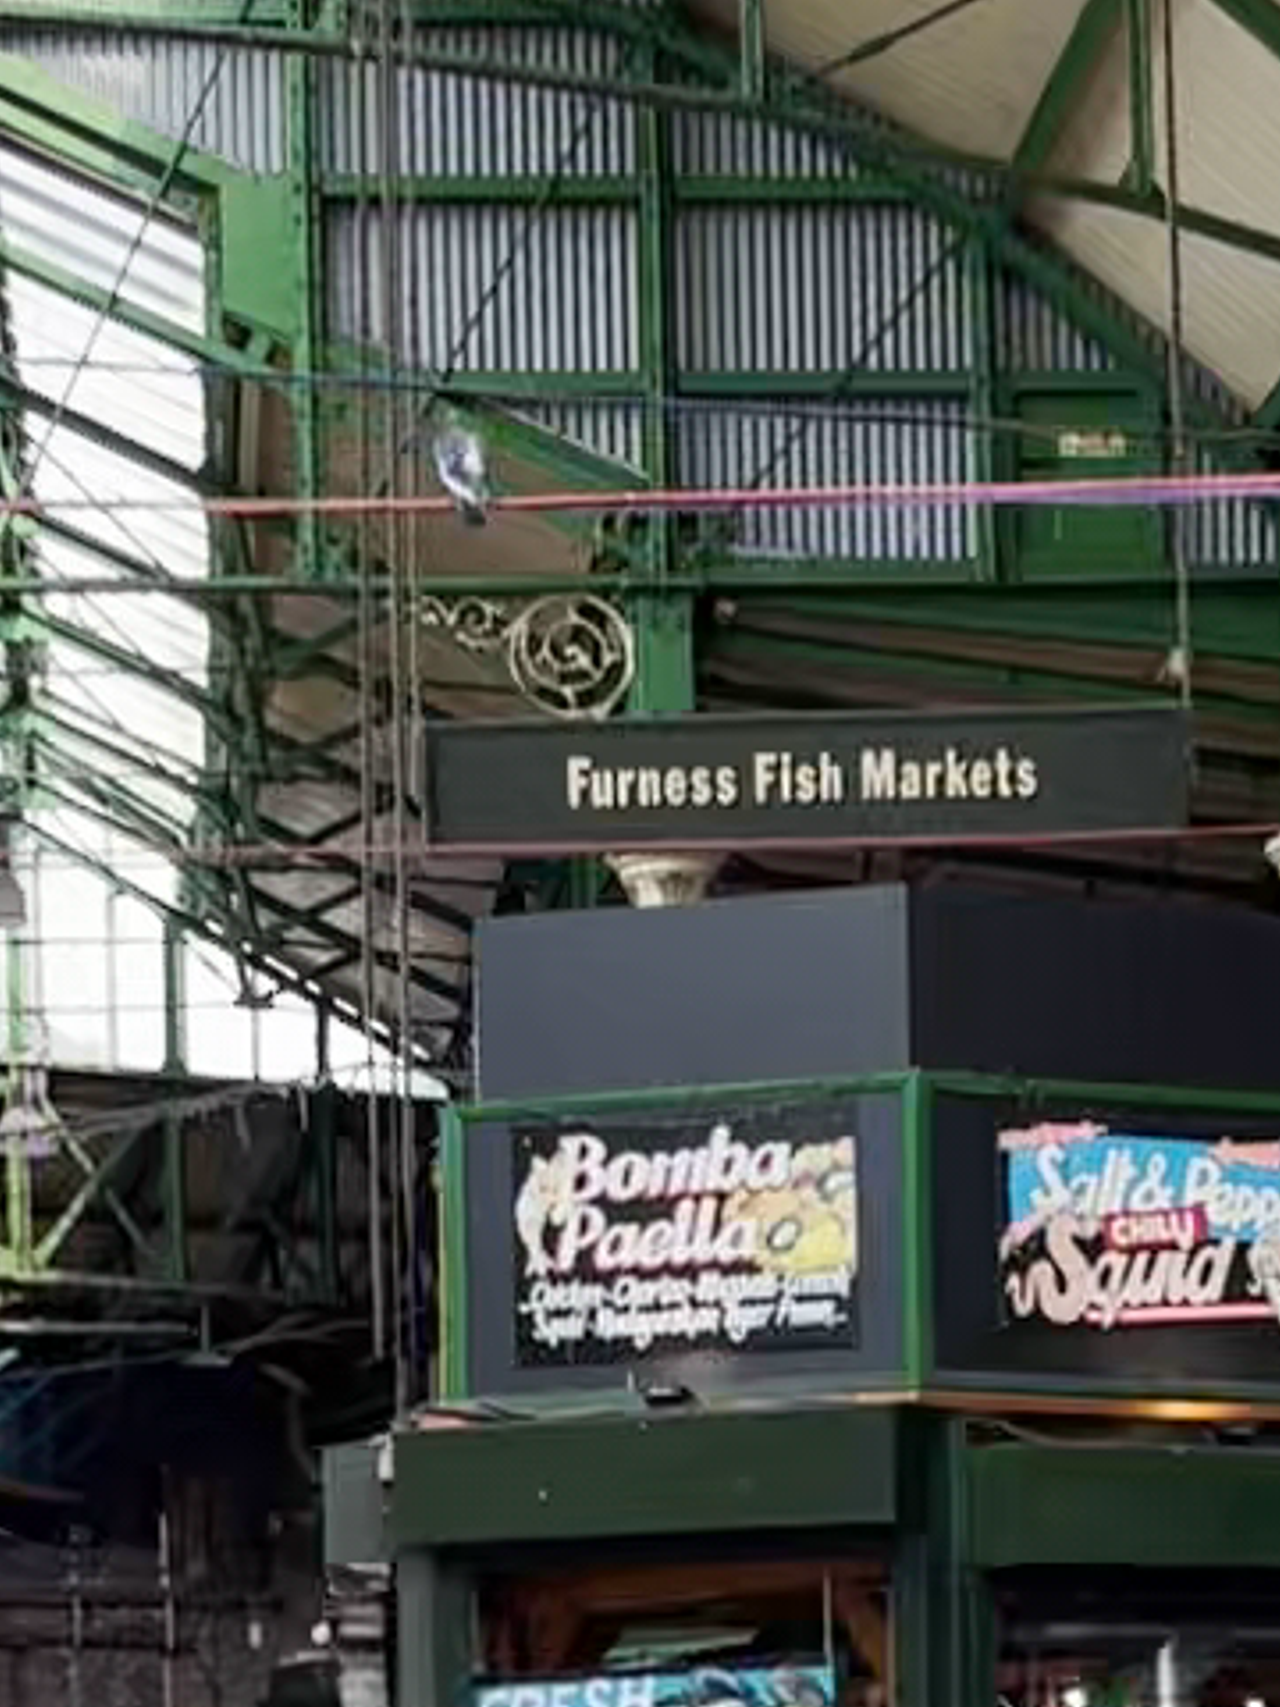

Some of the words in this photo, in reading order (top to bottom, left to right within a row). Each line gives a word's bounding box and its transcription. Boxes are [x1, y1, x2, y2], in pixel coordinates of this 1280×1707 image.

[565, 755, 739, 809] Furness
[753, 750, 843, 804] Fish
[861, 748, 1039, 801] Markets
[558, 1125, 792, 1202] Bomba
[1031, 1143, 1133, 1219] Salt
[1131, 1155, 1173, 1212] &
[558, 1196, 762, 1271] Paella
[1008, 1212, 1236, 1328] Squid
